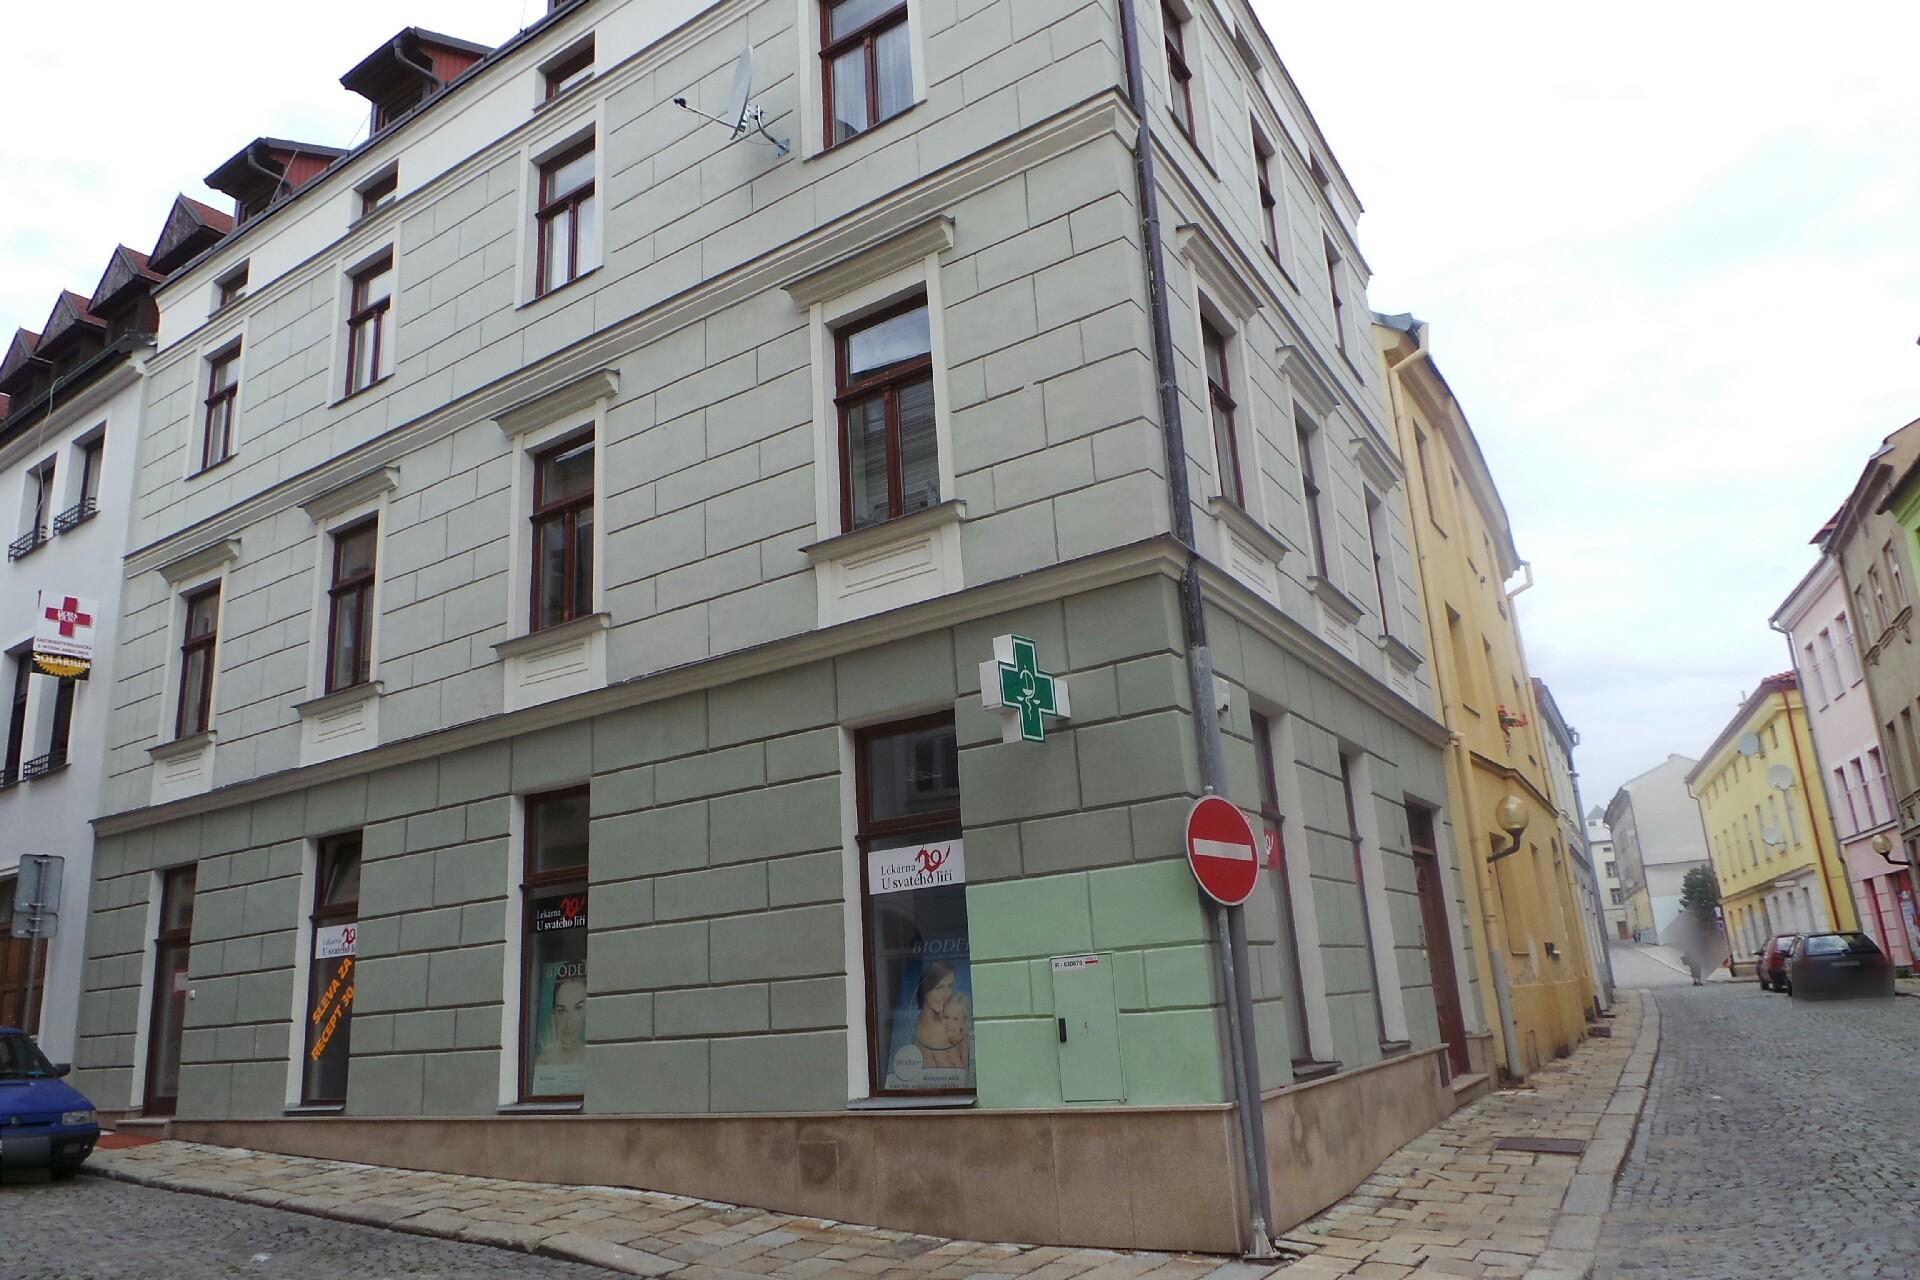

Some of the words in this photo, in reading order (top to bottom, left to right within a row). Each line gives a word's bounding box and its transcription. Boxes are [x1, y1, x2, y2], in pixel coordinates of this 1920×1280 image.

[882, 878, 892, 890] U
[537, 920, 544, 931] U
[312, 979, 340, 1025] SLEVA
[338, 958, 353, 980] ZA
[311, 1004, 342, 1061] RECEPT
